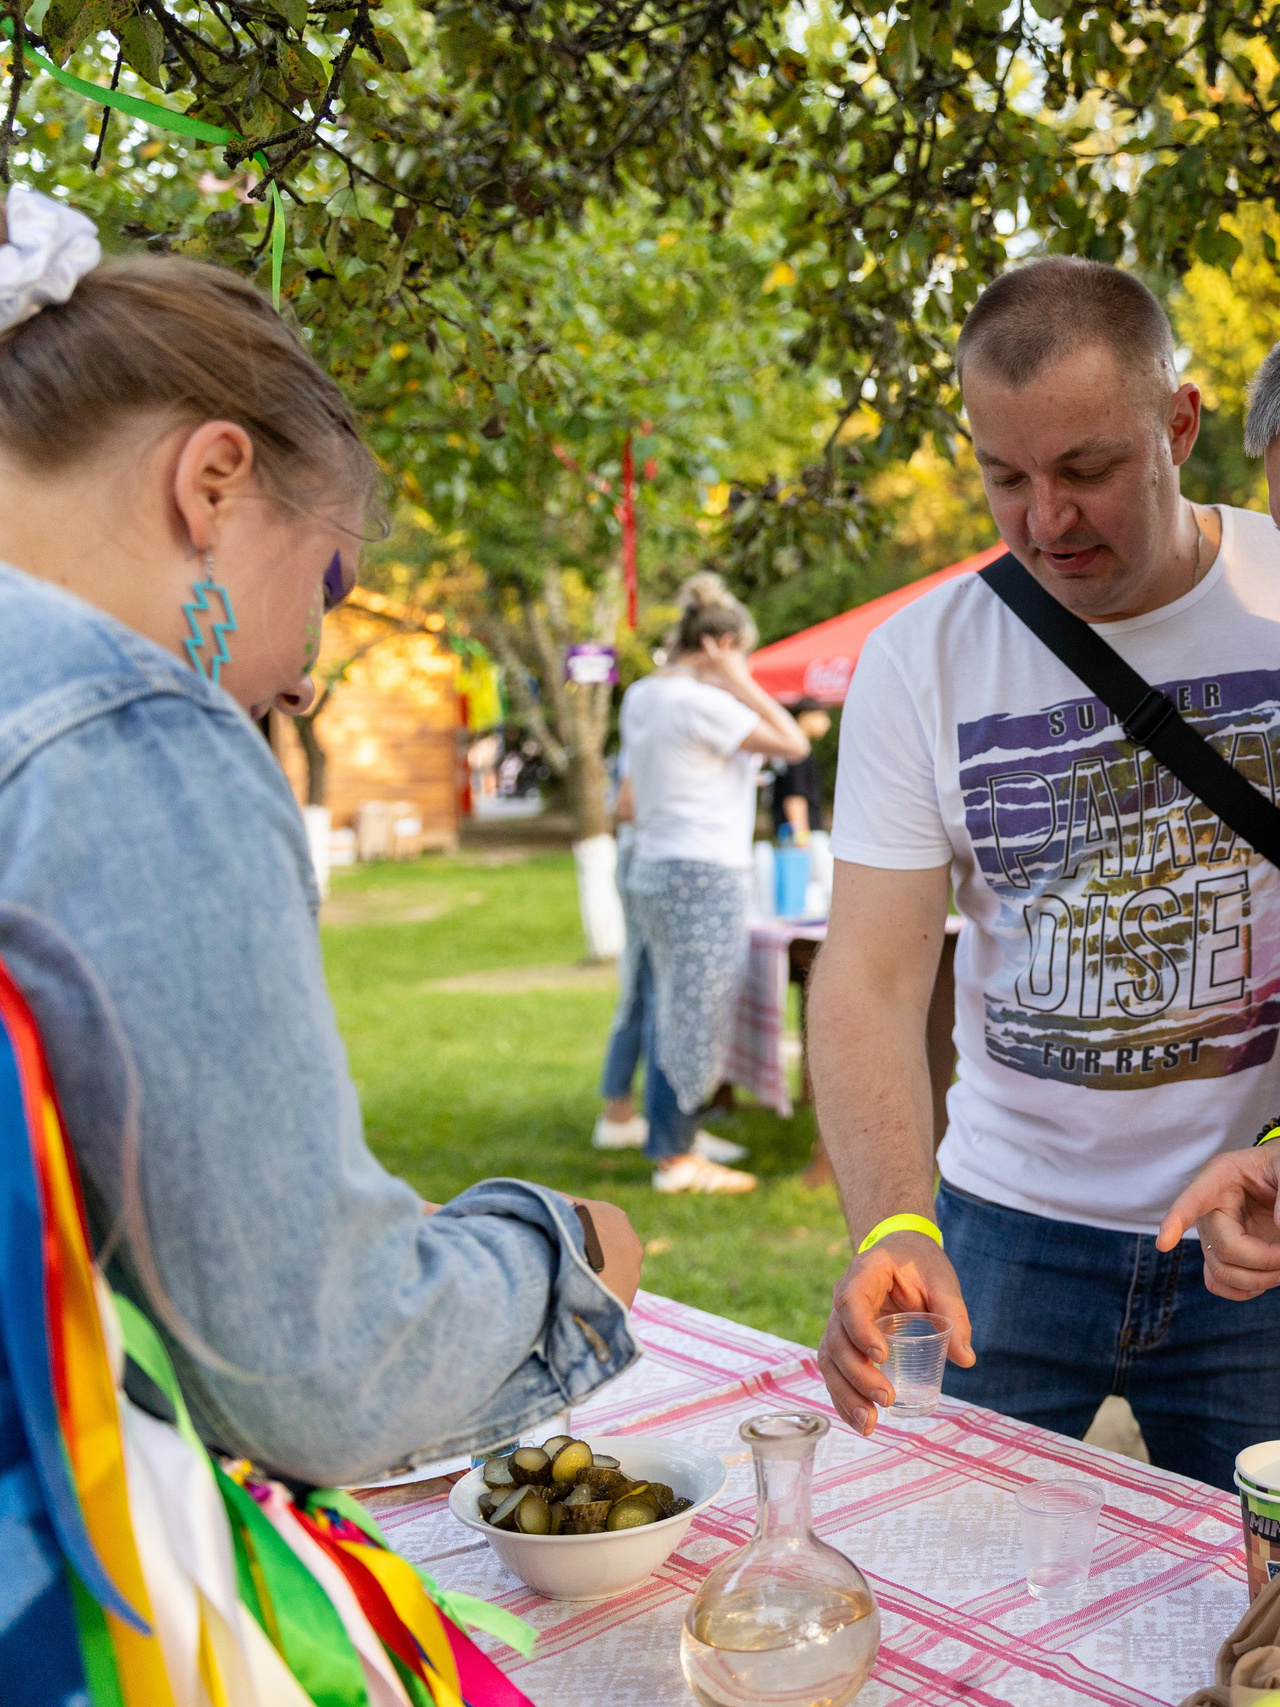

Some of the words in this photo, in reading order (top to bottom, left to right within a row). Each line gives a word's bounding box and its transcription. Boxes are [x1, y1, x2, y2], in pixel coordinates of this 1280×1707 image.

[1048, 682, 1222, 738] SUER
[1015, 870, 1249, 1019] DISE
[1042, 1039, 1101, 1075] FOR
[1114, 1036, 1204, 1075] REST
